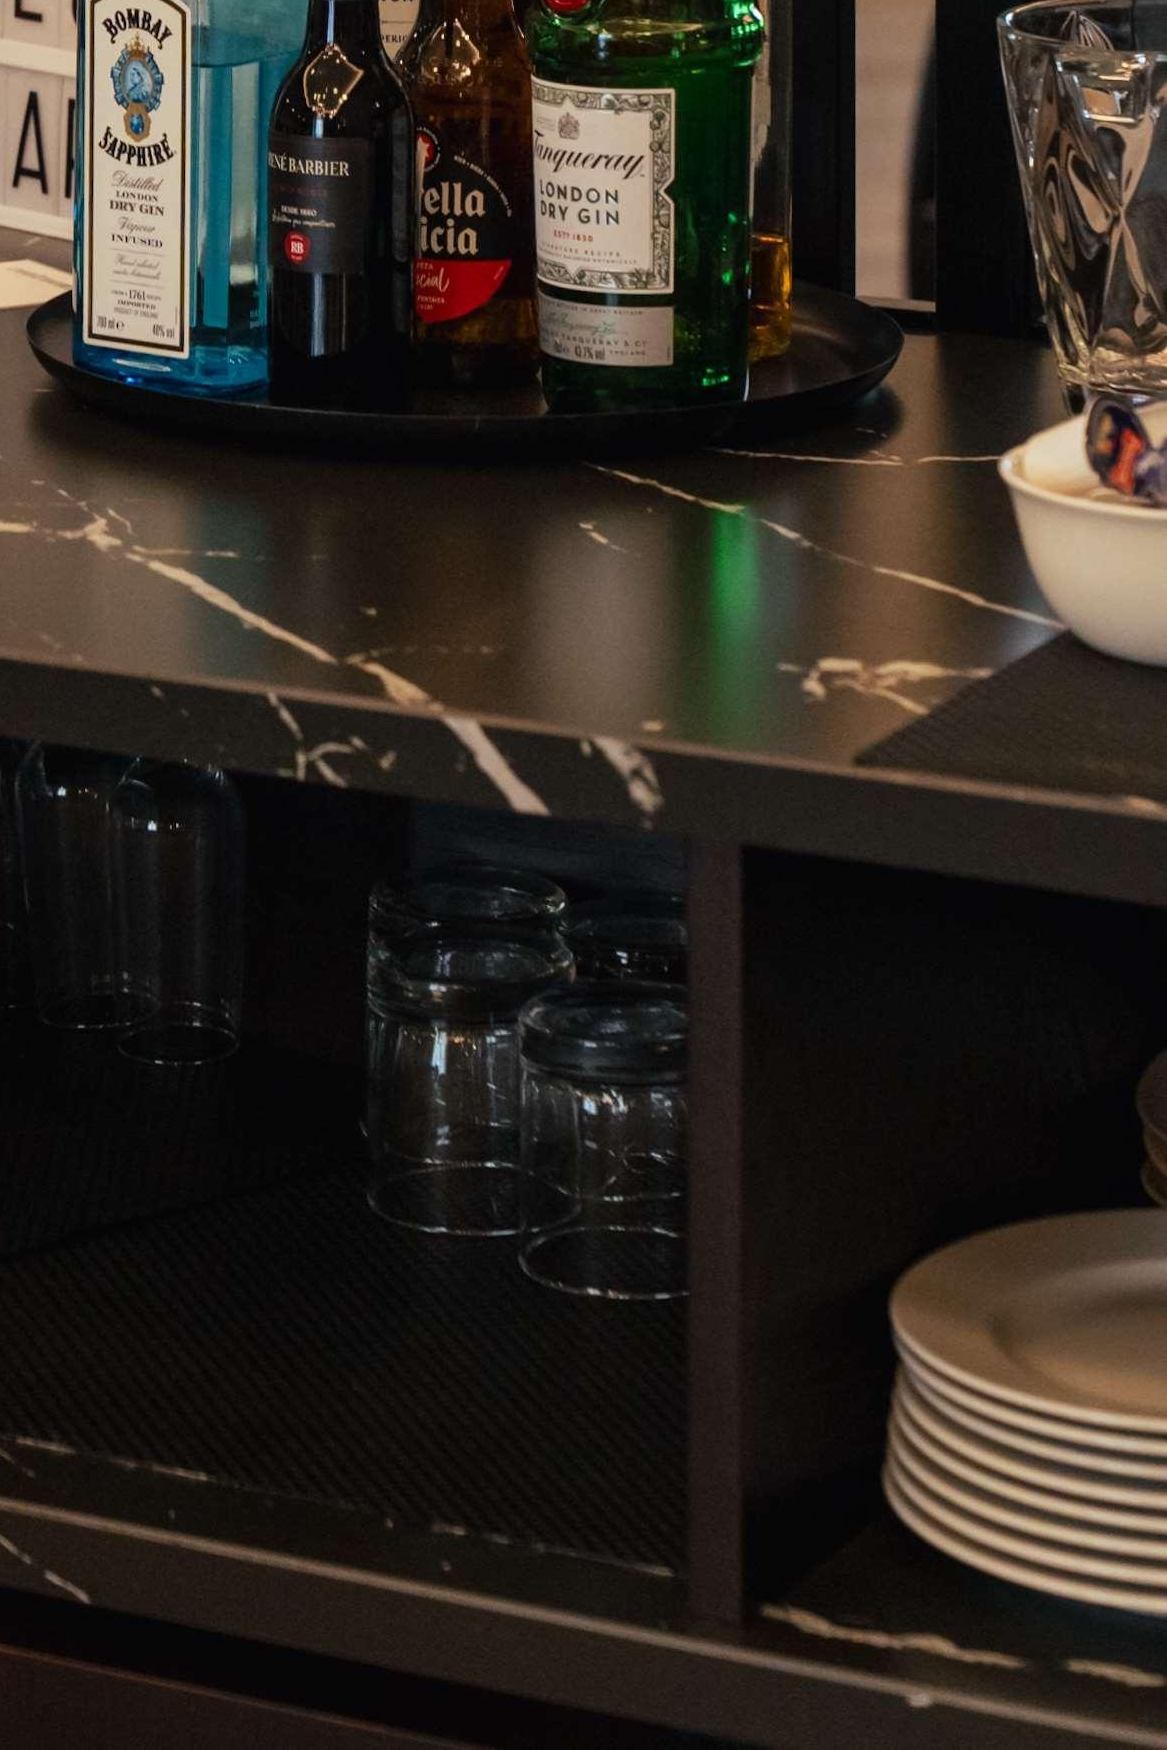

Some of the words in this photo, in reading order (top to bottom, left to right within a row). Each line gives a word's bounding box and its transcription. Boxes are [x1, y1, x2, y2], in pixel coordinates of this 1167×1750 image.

[102, 8, 173, 50] BOMBAY
[98, 126, 175, 167] SAPPHIRE
[534, 129, 645, 180] Tanqueray
[289, 157, 350, 177] BARBIER
[115, 190, 159, 202] LONDON
[539, 179, 619, 204] LONDON
[109, 199, 137, 213] DRY
[139, 203, 165, 217] GIN
[540, 200, 569, 222] DRY
[578, 207, 620, 225] GIN
[111, 233, 163, 248] INFUSED
[290, 241, 304, 255] RB
[129, 289, 146, 301] 1761
